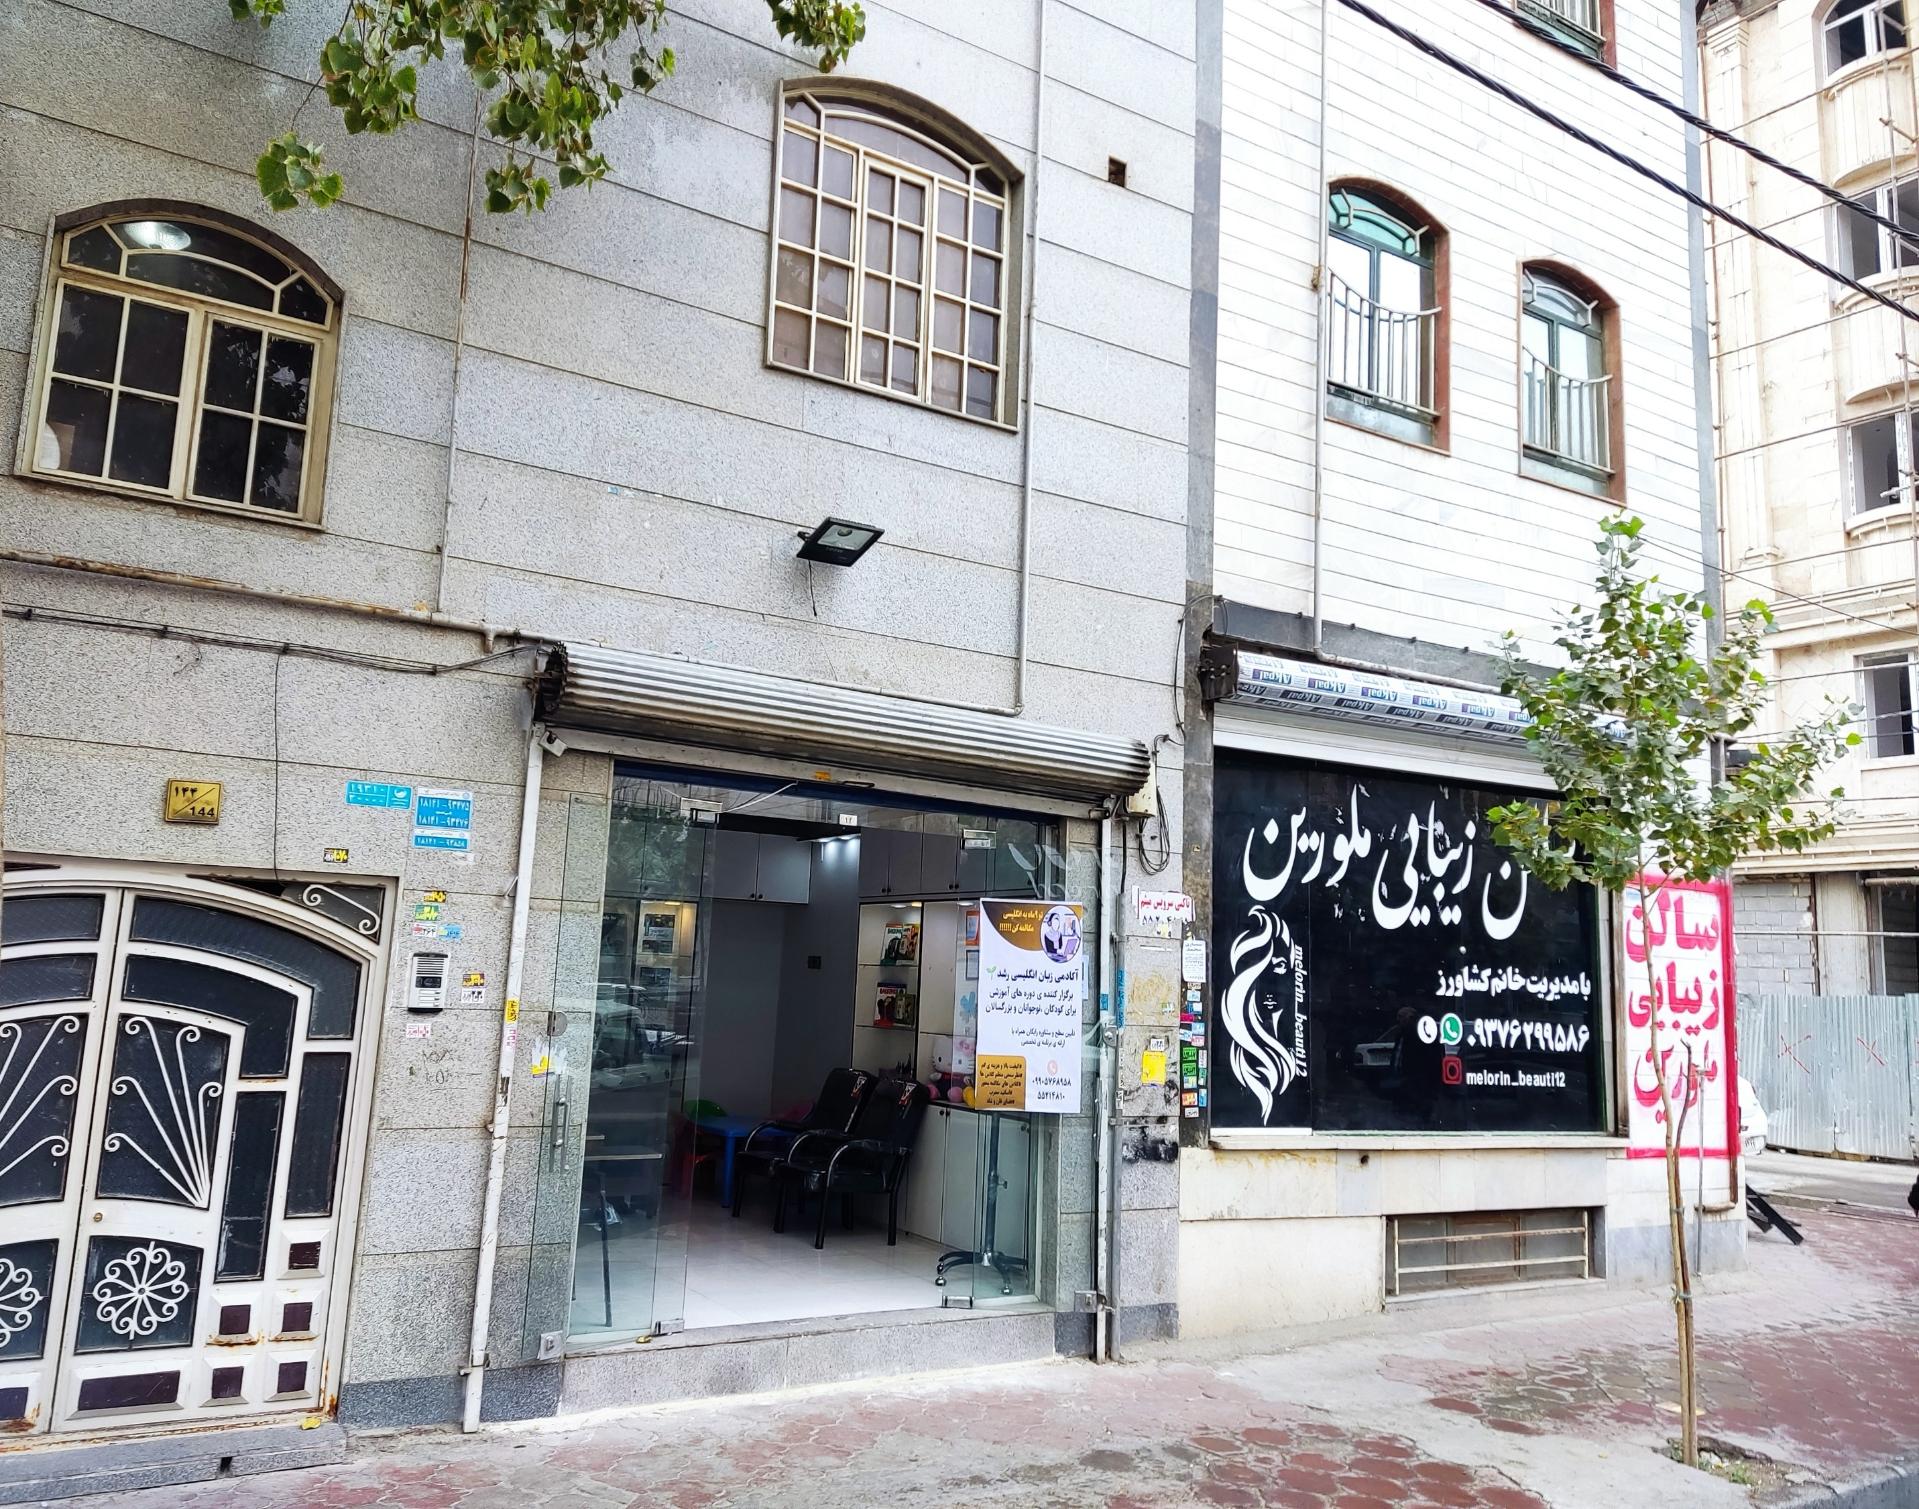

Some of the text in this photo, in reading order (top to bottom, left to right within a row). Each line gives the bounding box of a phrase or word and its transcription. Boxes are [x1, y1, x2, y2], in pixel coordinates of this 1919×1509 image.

[190, 806, 215, 817] 144
[1243, 784, 1371, 901] ملورین
[1372, 800, 1476, 930] زیبایی
[1626, 888, 1720, 963] سالن
[997, 969, 1079, 983] آکادمی زبان انگلیسی رشد
[1435, 964, 1591, 1001] با مدیریت خانم کشاورز
[1011, 988, 1022, 999] های
[1024, 991, 1035, 1000] دوره
[1059, 989, 1073, 1001] برگزار
[1628, 961, 1720, 1035] زیبایی
[1044, 1003, 1064, 1015] کودکان
[1065, 1005, 1077, 1016] برای
[1466, 1069, 1566, 1087] melorin_beauti12
